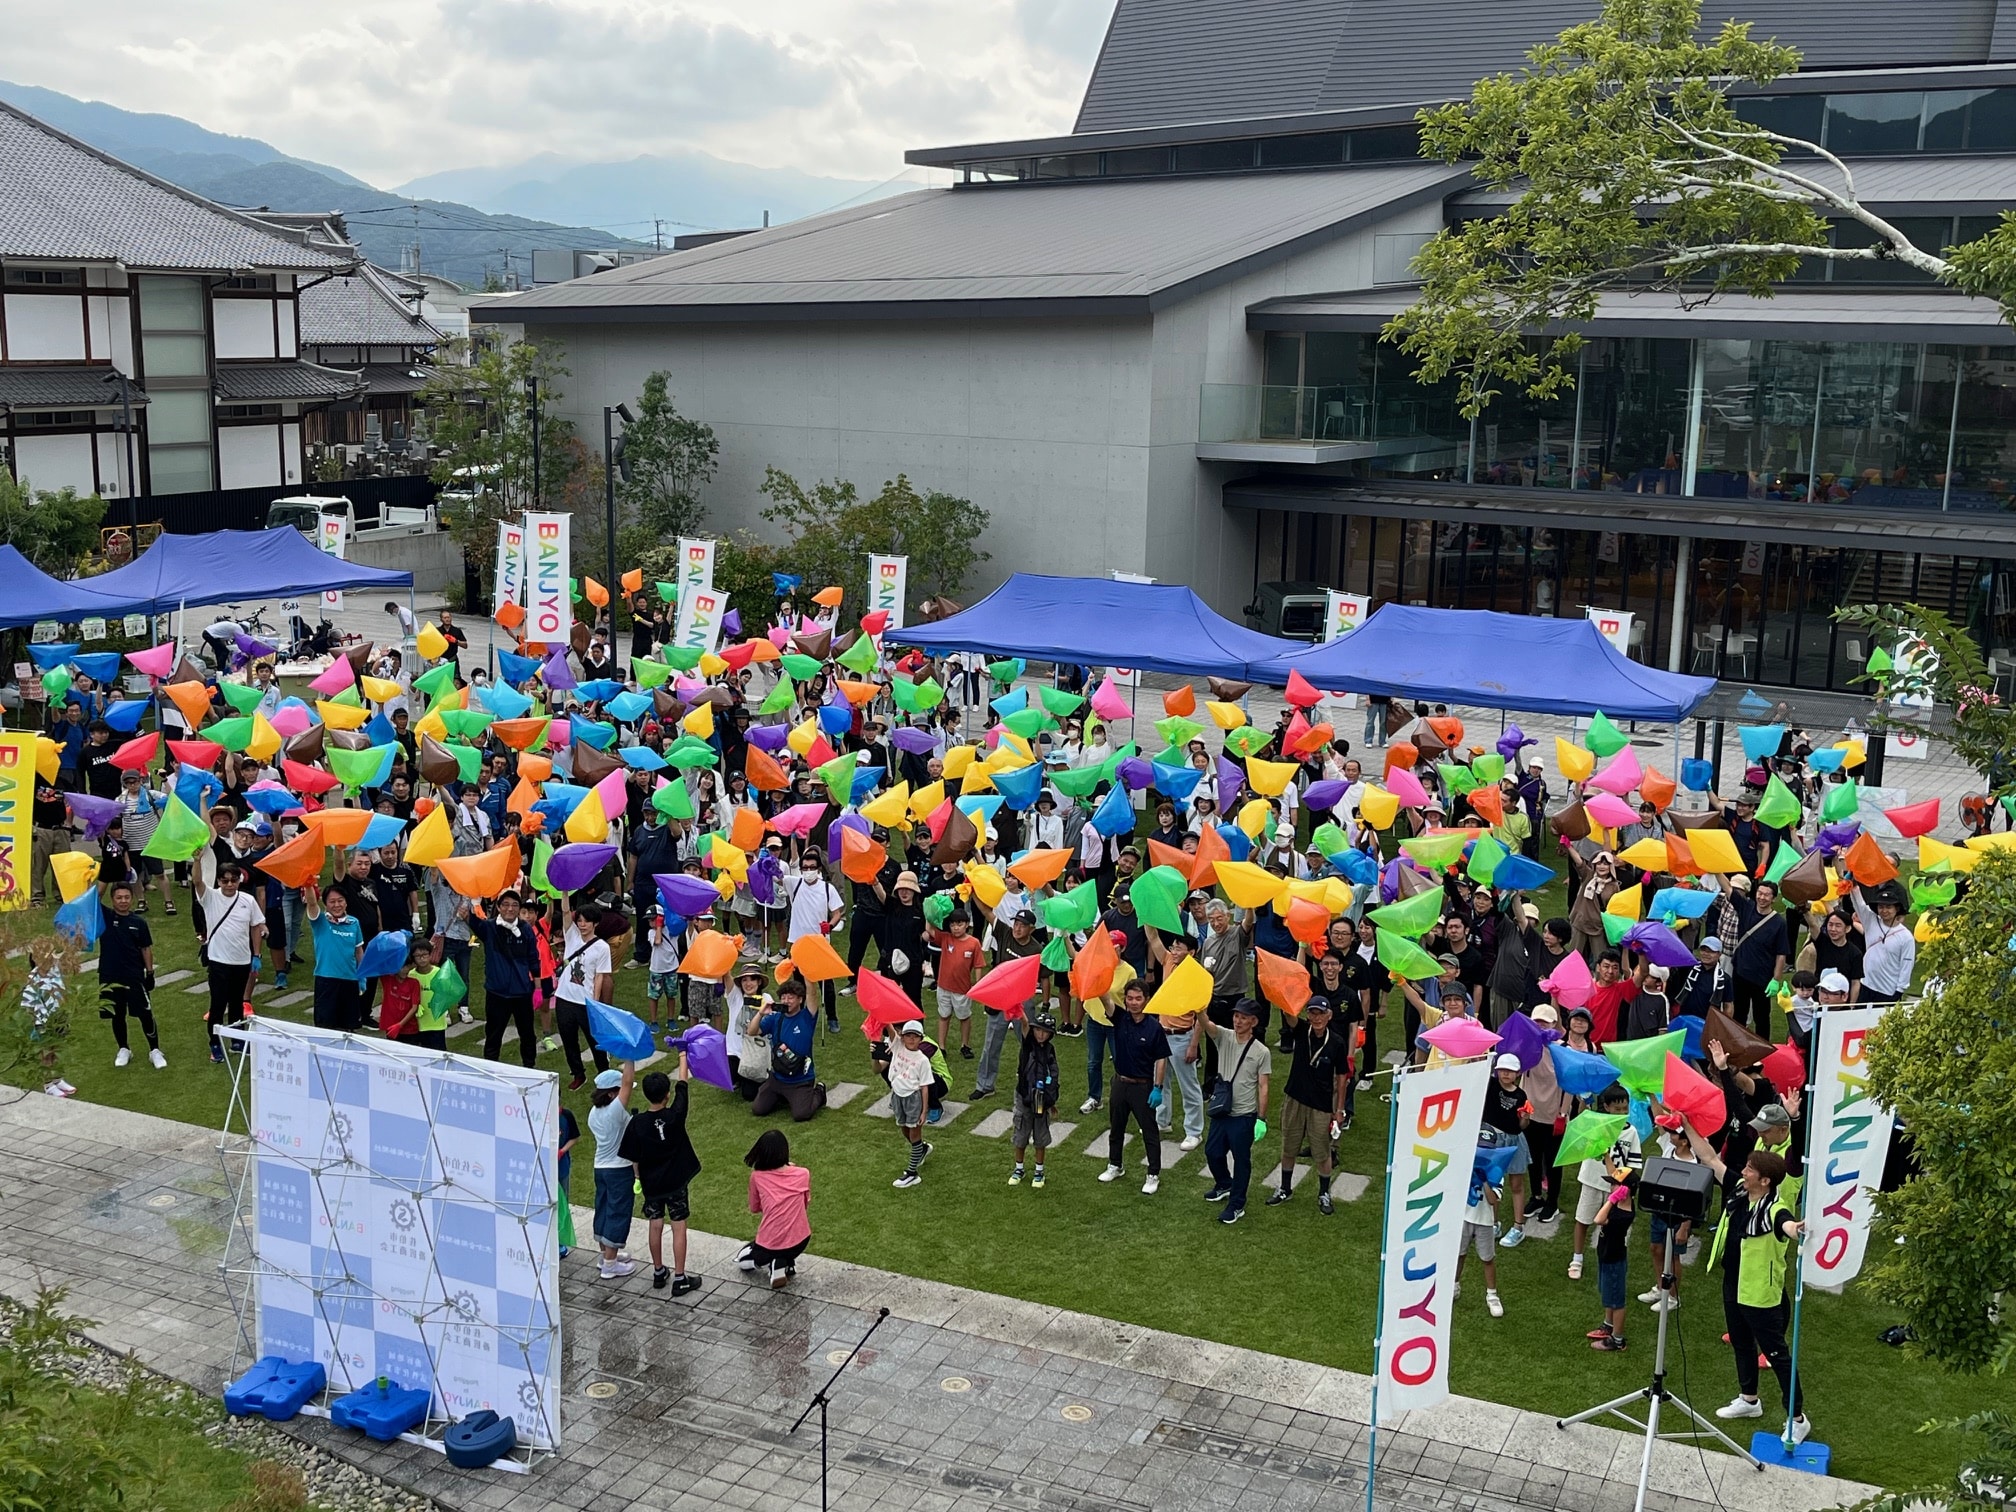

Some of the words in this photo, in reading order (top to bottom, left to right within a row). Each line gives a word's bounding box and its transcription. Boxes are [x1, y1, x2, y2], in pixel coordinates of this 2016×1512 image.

[539, 523, 559, 633] BANJYO
[686, 595, 715, 649] BAN
[1390, 1088, 1461, 1386] BANJYO
[1815, 1030, 1873, 1270] BANJYO
